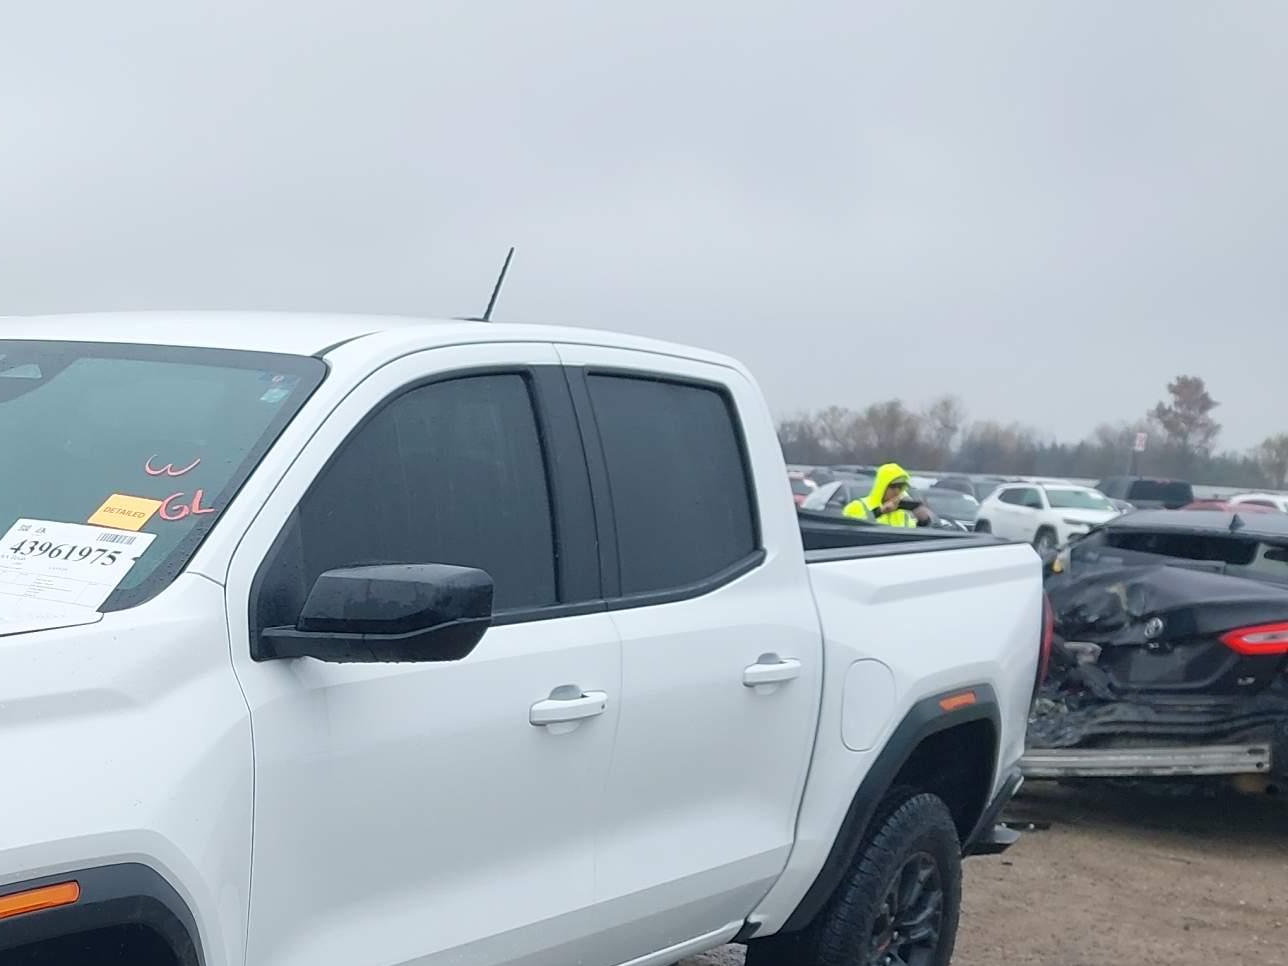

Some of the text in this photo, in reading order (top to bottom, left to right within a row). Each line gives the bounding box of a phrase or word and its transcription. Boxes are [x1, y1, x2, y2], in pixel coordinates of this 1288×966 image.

[103, 506, 146, 520] DETAILED
[159, 489, 216, 521] GL
[10, 538, 123, 567] 43961975
